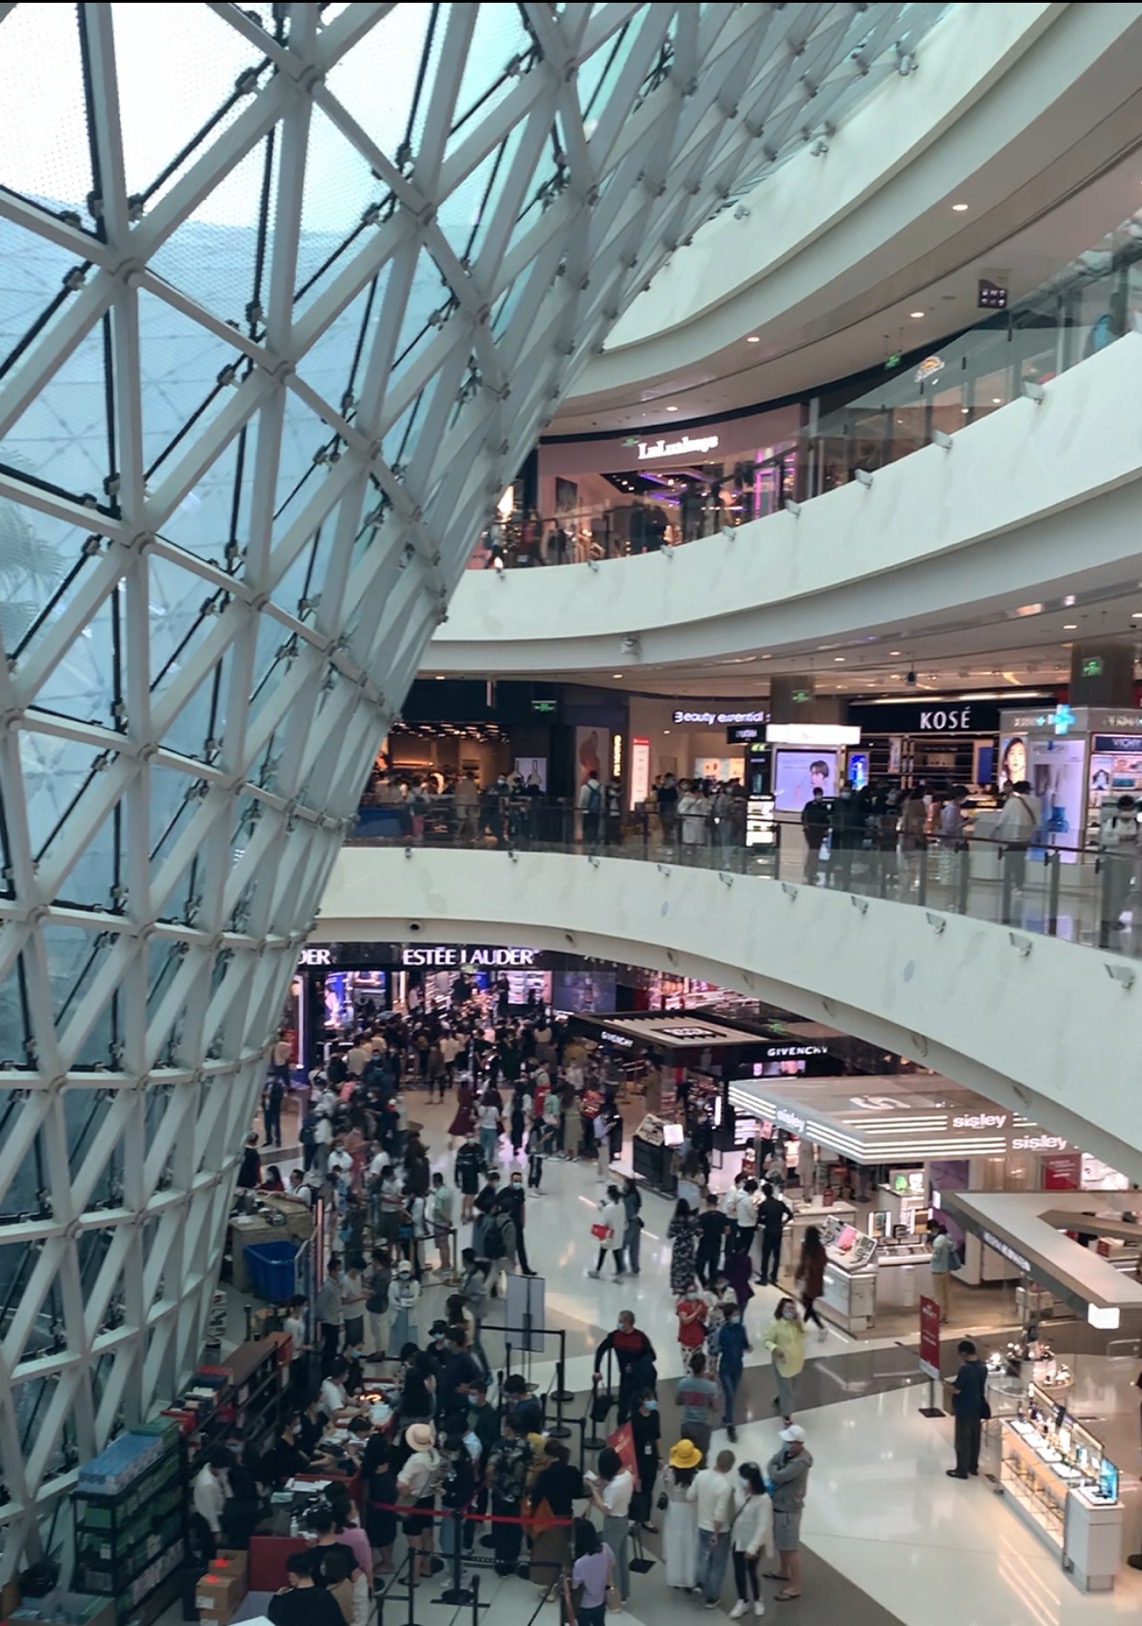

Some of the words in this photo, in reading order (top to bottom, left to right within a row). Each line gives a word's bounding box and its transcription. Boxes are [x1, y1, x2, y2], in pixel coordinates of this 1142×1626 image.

[920, 706, 971, 729] KOSÉ
[402, 947, 457, 965] ESTÉE
[767, 1046, 828, 1057] GIVENCHY
[952, 1112, 1007, 1129] sisley
[1011, 1134, 1067, 1151] sisley
